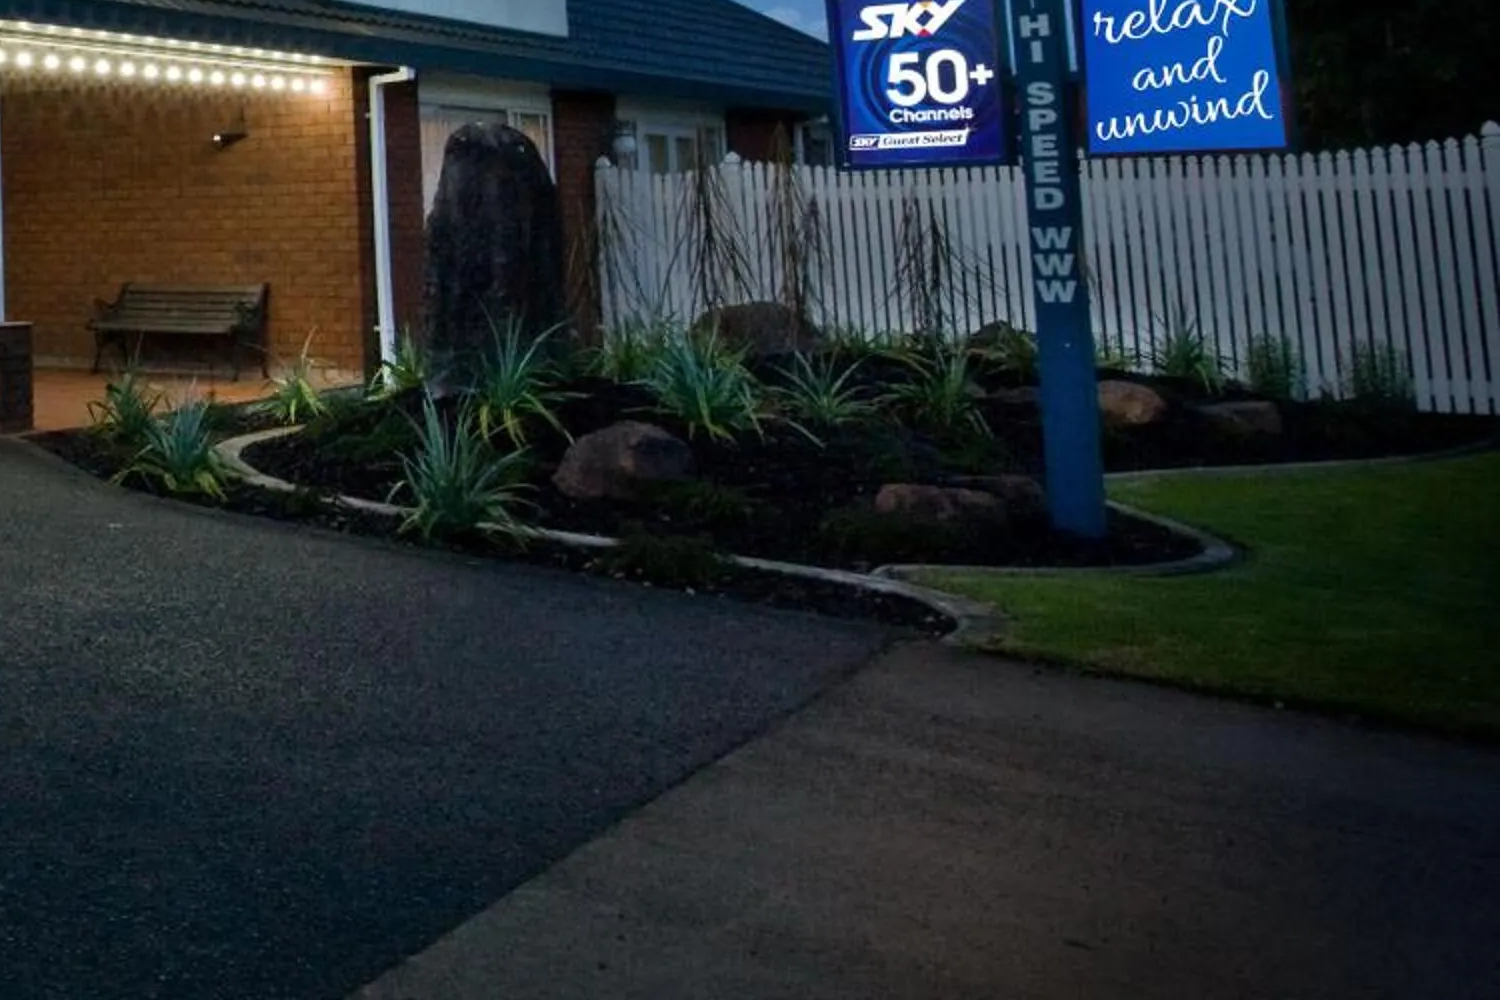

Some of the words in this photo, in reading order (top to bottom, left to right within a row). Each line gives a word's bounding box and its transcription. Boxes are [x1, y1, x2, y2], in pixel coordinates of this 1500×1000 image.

[1018, 12, 1051, 63] HI
[1132, 35, 1227, 91] and
[886, 49, 994, 107] 50+
[1096, 69, 1274, 141] unwind
[851, 135, 881, 148] SKY
[882, 134, 920, 146] Guest
[923, 132, 963, 144] Select
[889, 106, 974, 124] Channels
[1026, 81, 1065, 210] SPEED
